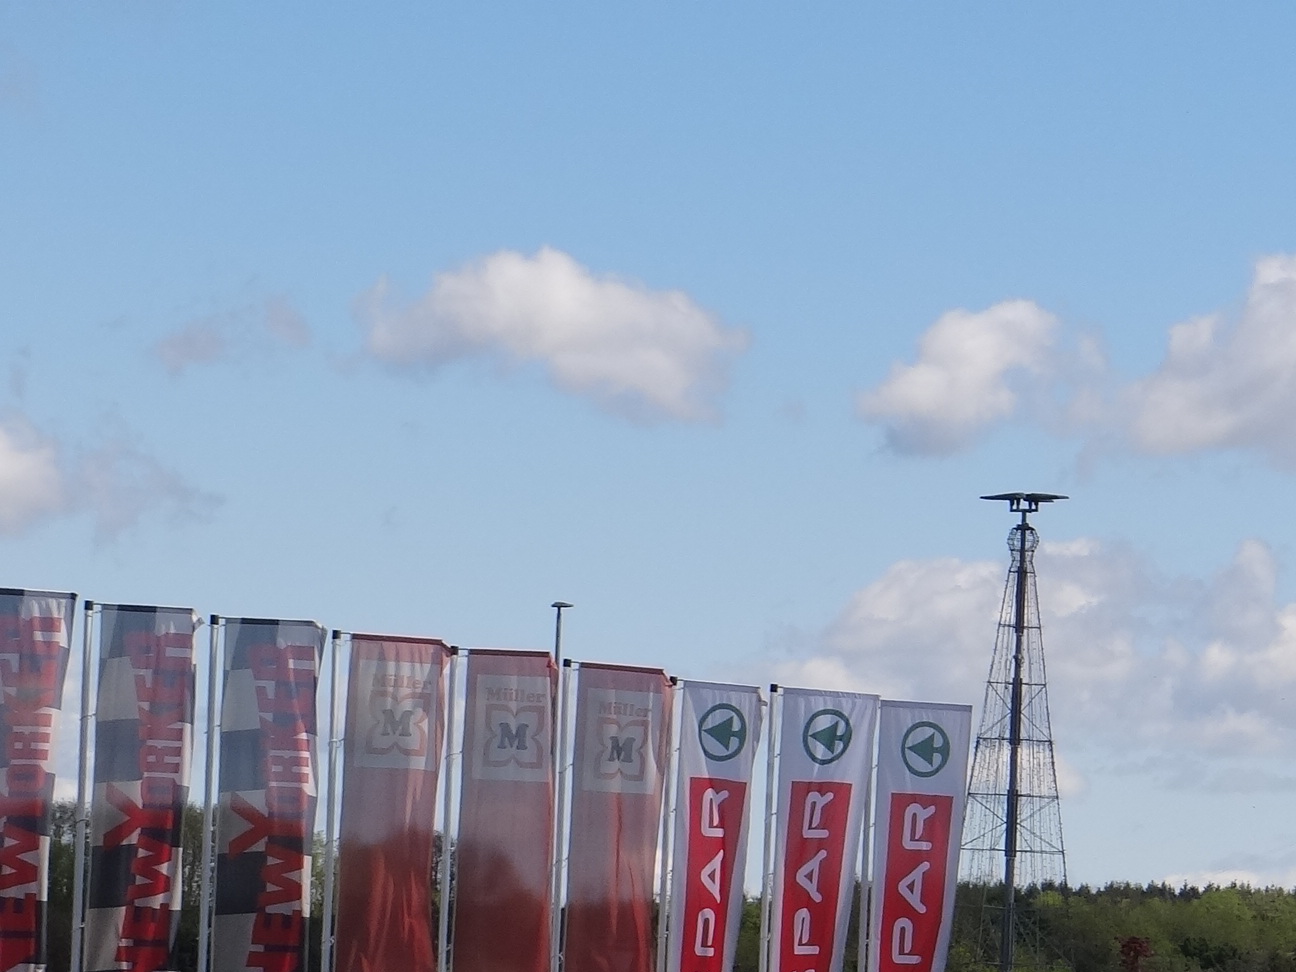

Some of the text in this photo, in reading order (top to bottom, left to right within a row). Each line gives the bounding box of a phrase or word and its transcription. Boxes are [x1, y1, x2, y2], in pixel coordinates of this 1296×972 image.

[372, 673, 432, 692] Müller
[486, 687, 546, 704] Müller
[601, 700, 652, 718] Müller
[380, 708, 413, 738] M
[497, 722, 530, 751] M
[607, 735, 636, 764] M
